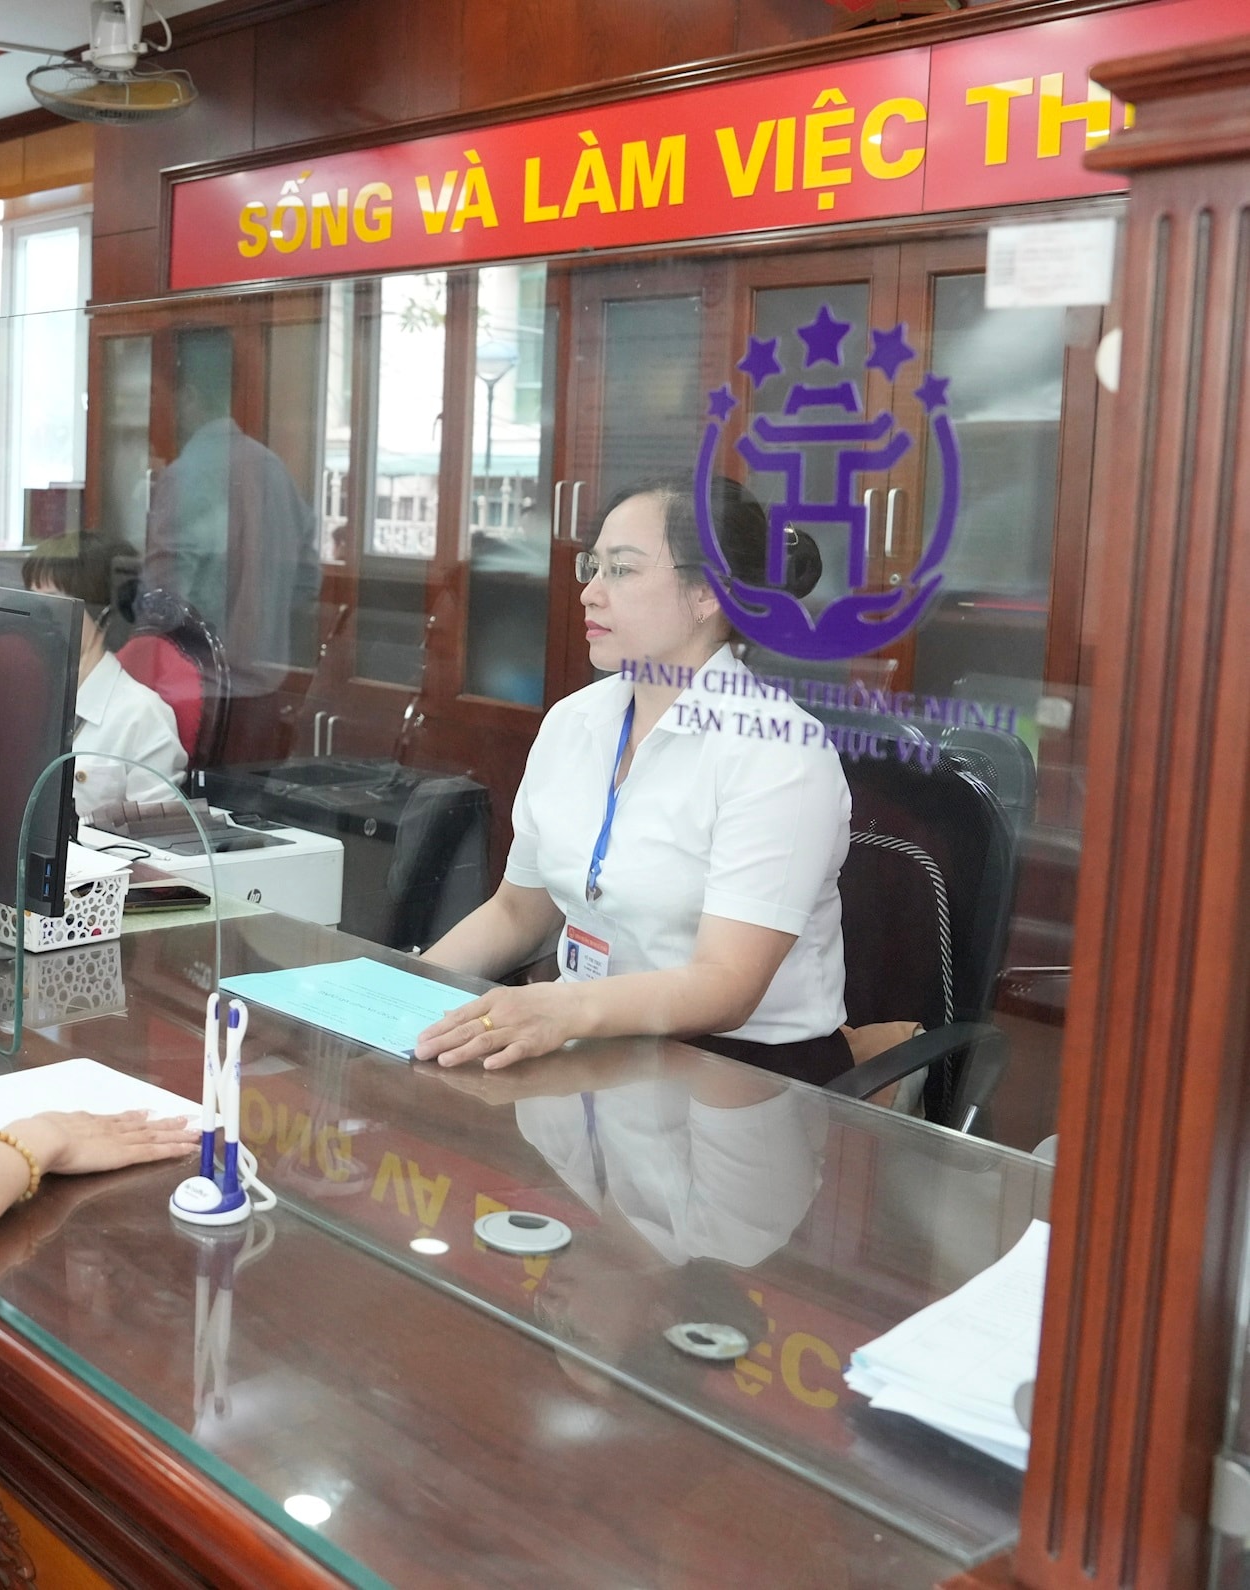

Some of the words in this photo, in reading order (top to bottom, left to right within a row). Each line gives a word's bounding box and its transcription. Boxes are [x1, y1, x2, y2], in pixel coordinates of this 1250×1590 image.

[238, 170, 393, 257] SỐNG
[415, 149, 499, 234] VÀ
[523, 130, 686, 224] LÀM
[714, 88, 927, 211] VIỆC
[621, 656, 694, 689] HÀNH
[703, 667, 791, 704] CHÍNH
[802, 679, 915, 720] THÔNG
[924, 695, 1019, 735] MINH
[673, 700, 723, 735] TẬN
[734, 710, 790, 743] TÂM
[802, 720, 887, 763] PHỤC
[897, 737, 941, 775] VỤ
